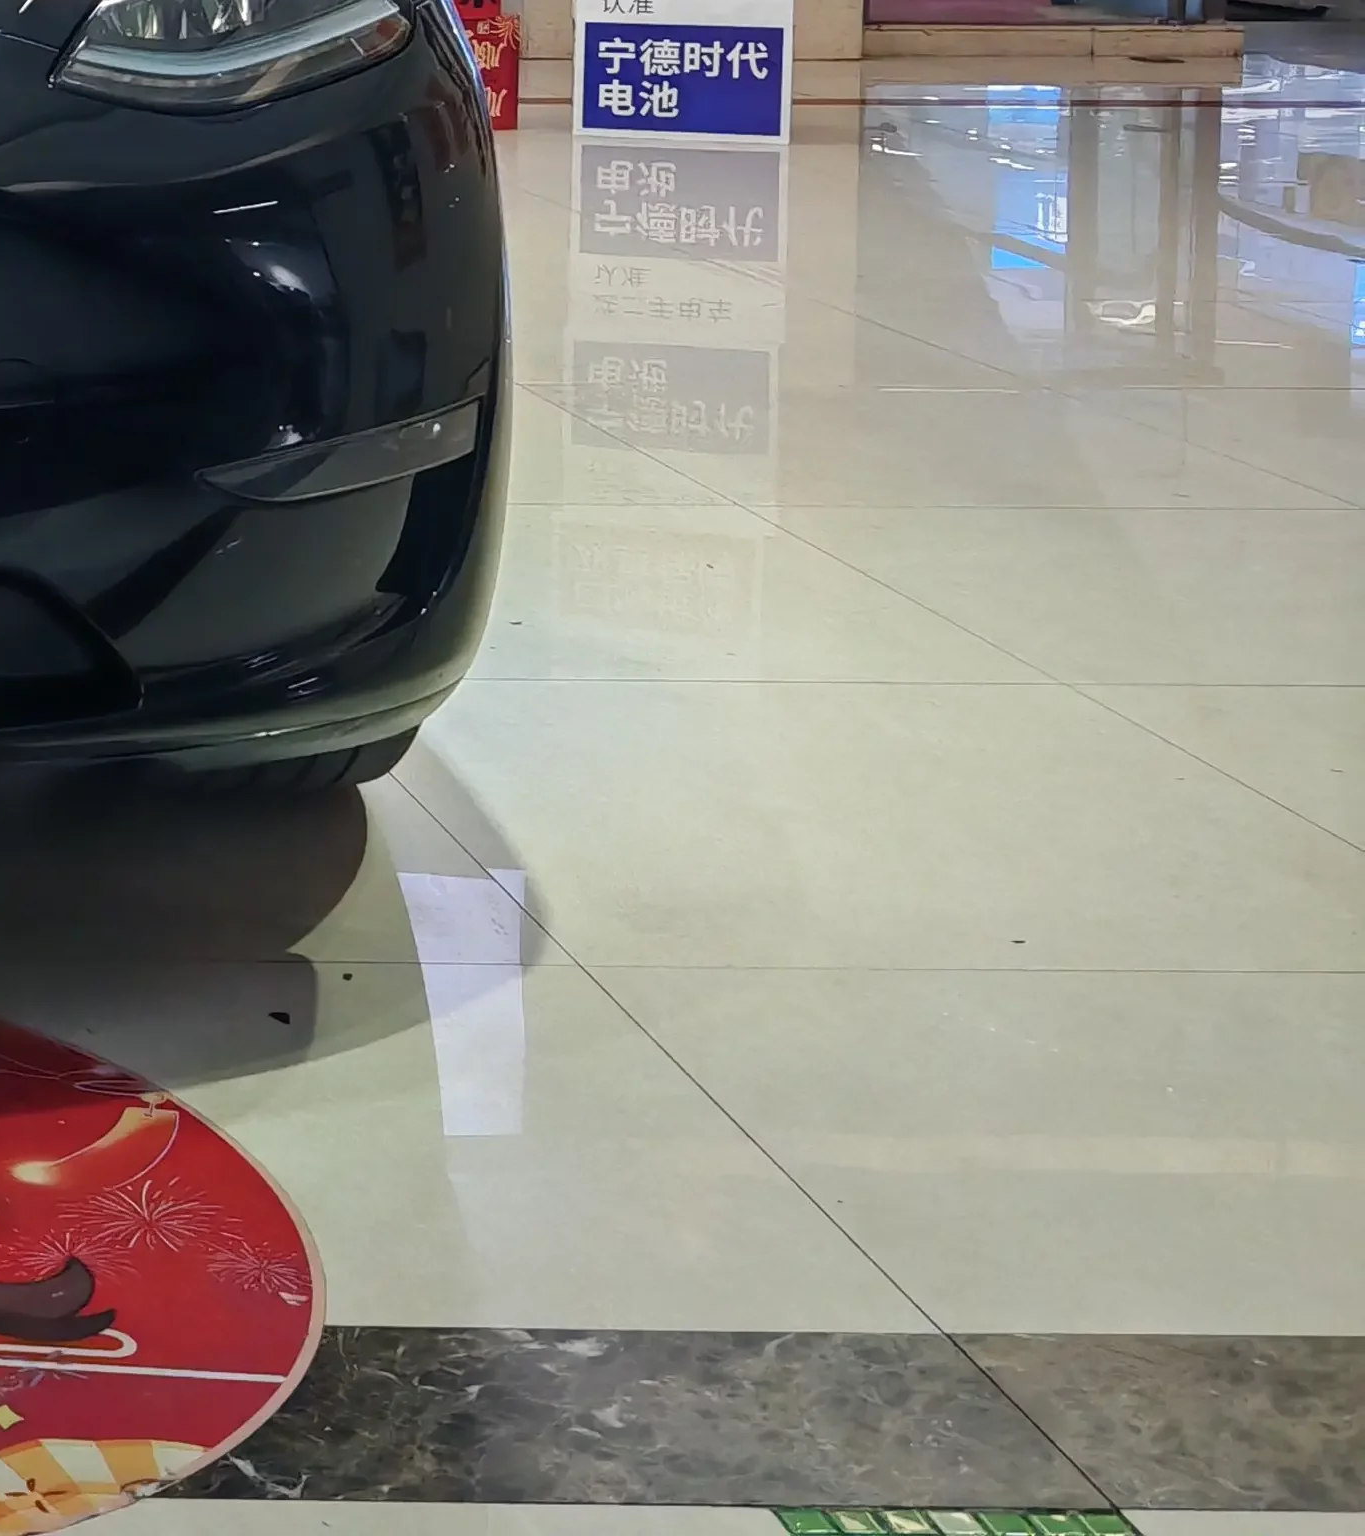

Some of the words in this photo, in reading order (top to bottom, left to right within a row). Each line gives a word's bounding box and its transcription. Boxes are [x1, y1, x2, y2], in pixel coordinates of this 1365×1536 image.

[597, 37, 770, 80] 宁德时代
[597, 79, 681, 119] 电池
